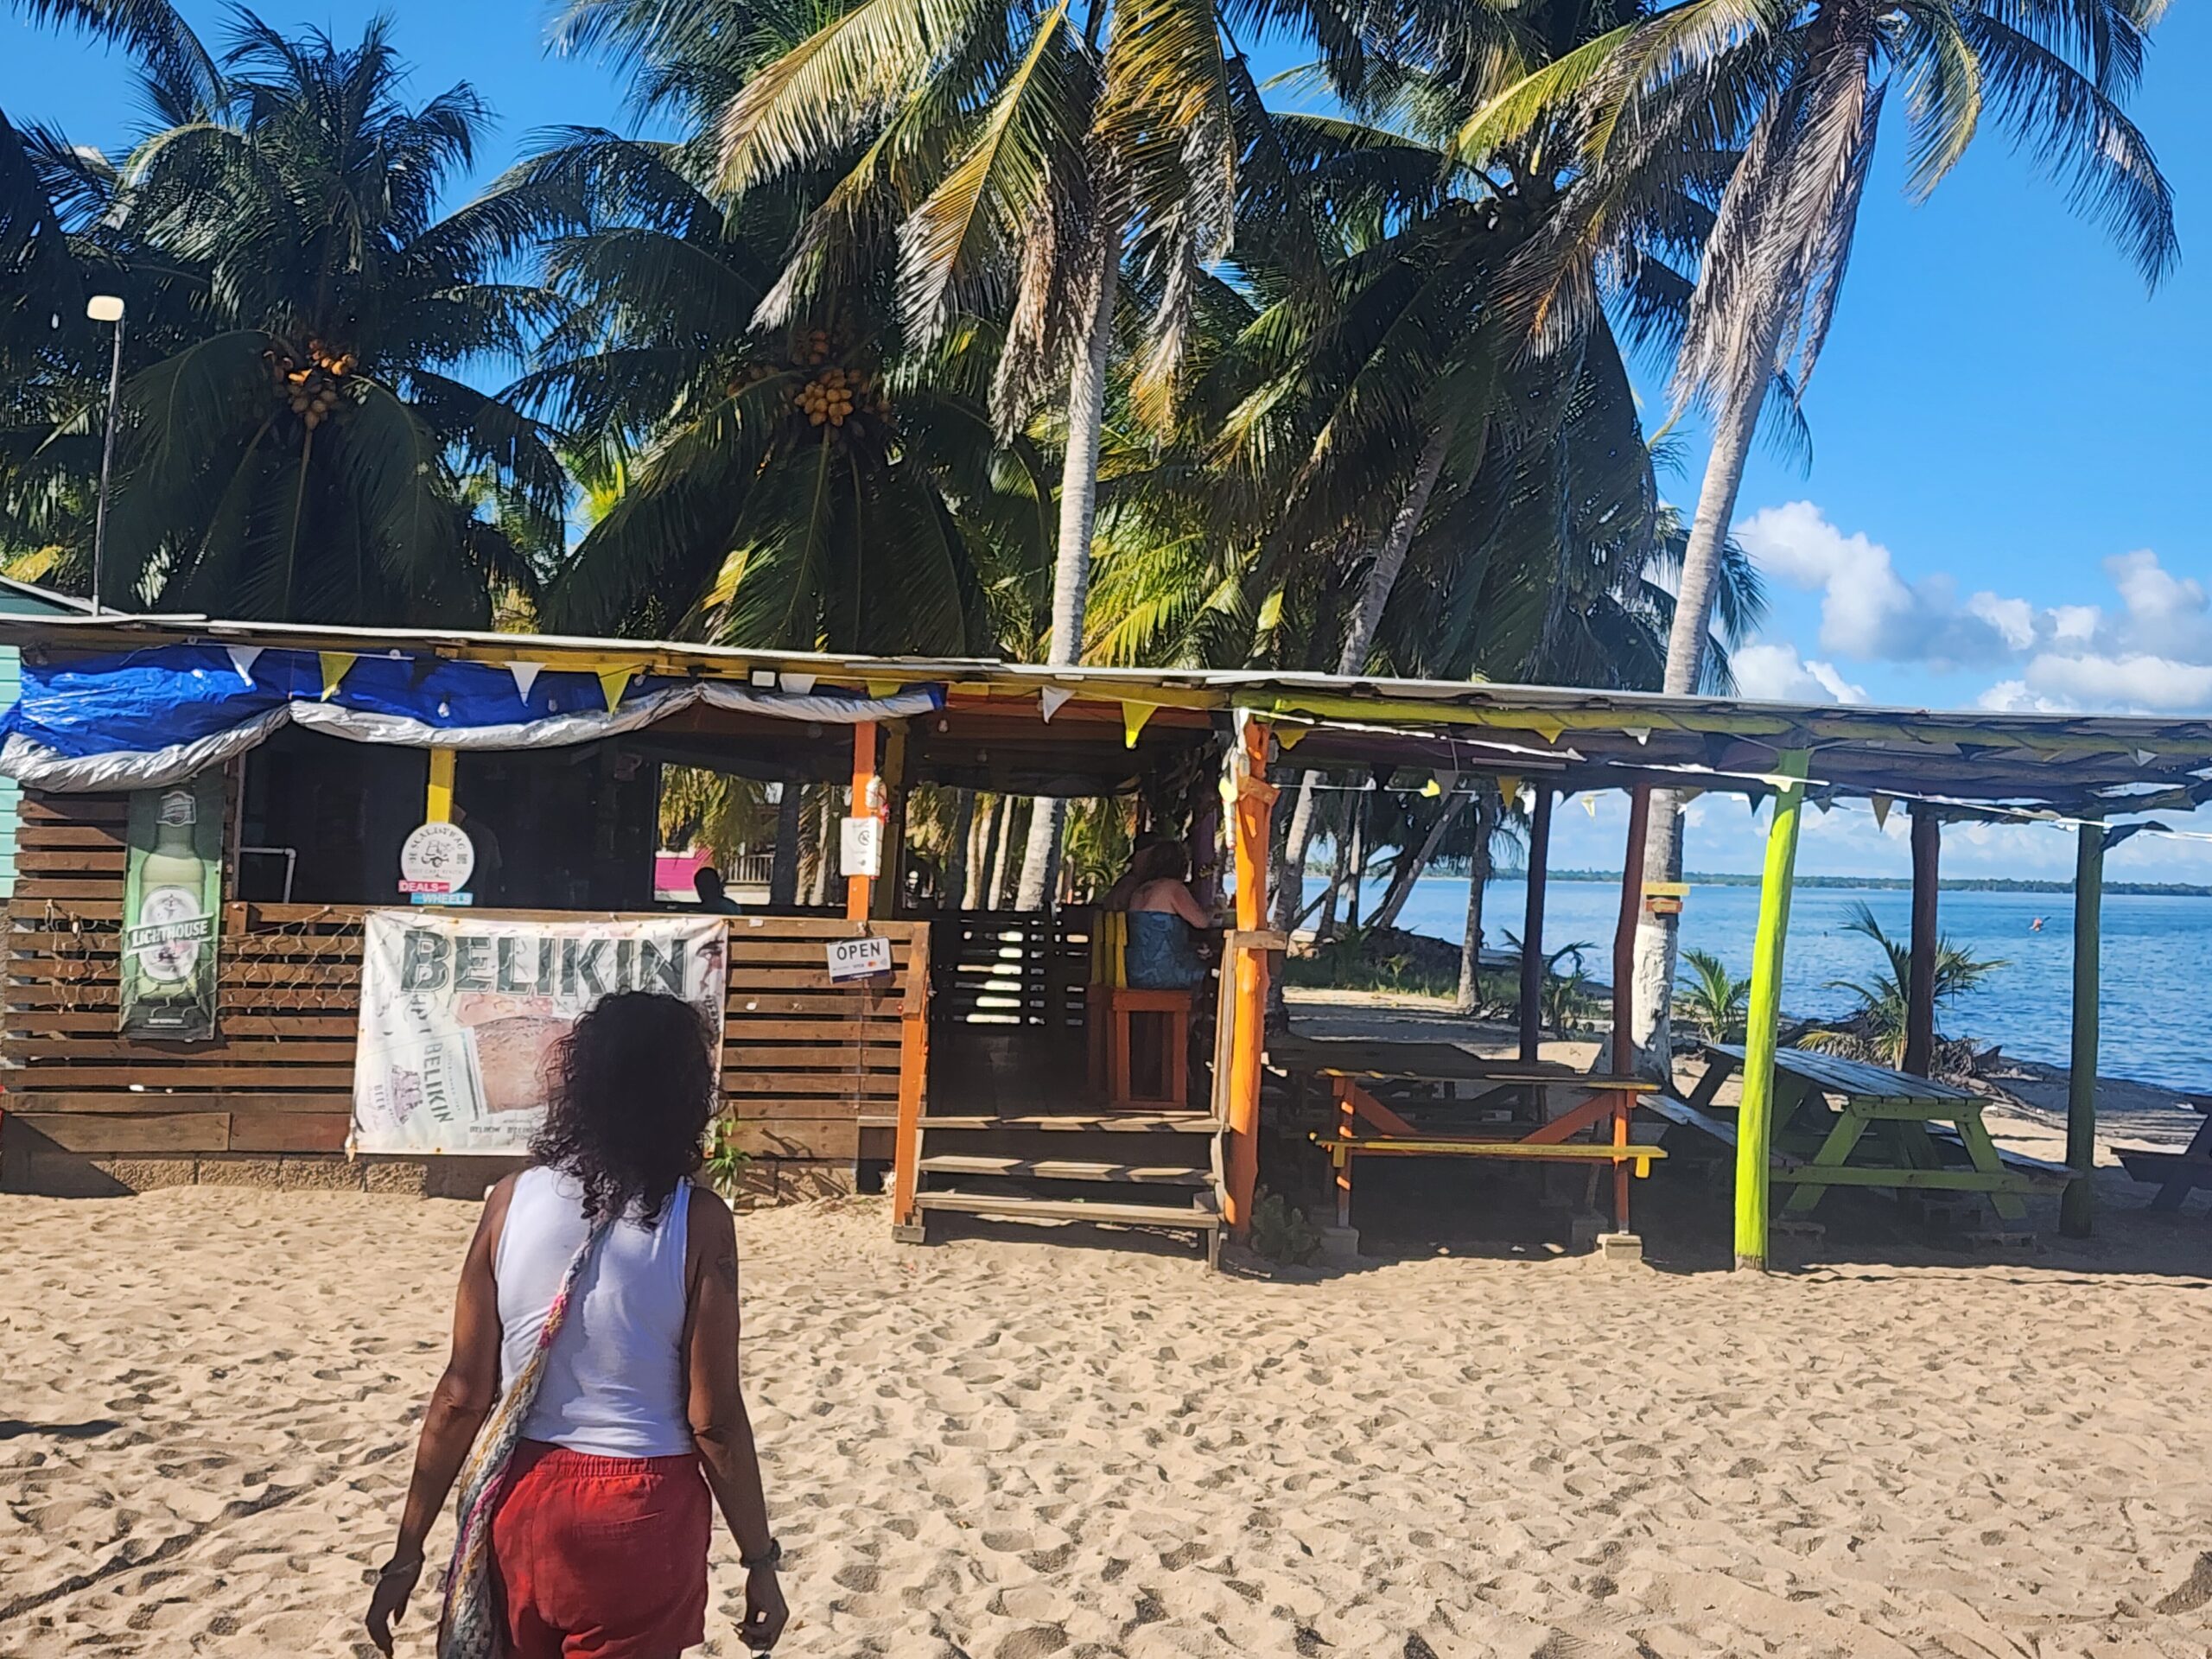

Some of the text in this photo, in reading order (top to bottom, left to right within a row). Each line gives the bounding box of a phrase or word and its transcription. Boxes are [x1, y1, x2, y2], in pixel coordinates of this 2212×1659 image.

[399, 880, 439, 893] DEALS
[423, 893, 471, 904] WHEELS
[131, 919, 208, 948] LIGHTHOUSE
[836, 941, 880, 960] OPEN
[400, 929, 689, 997] BELIKIN
[424, 1043, 454, 1122] BELIKIN
